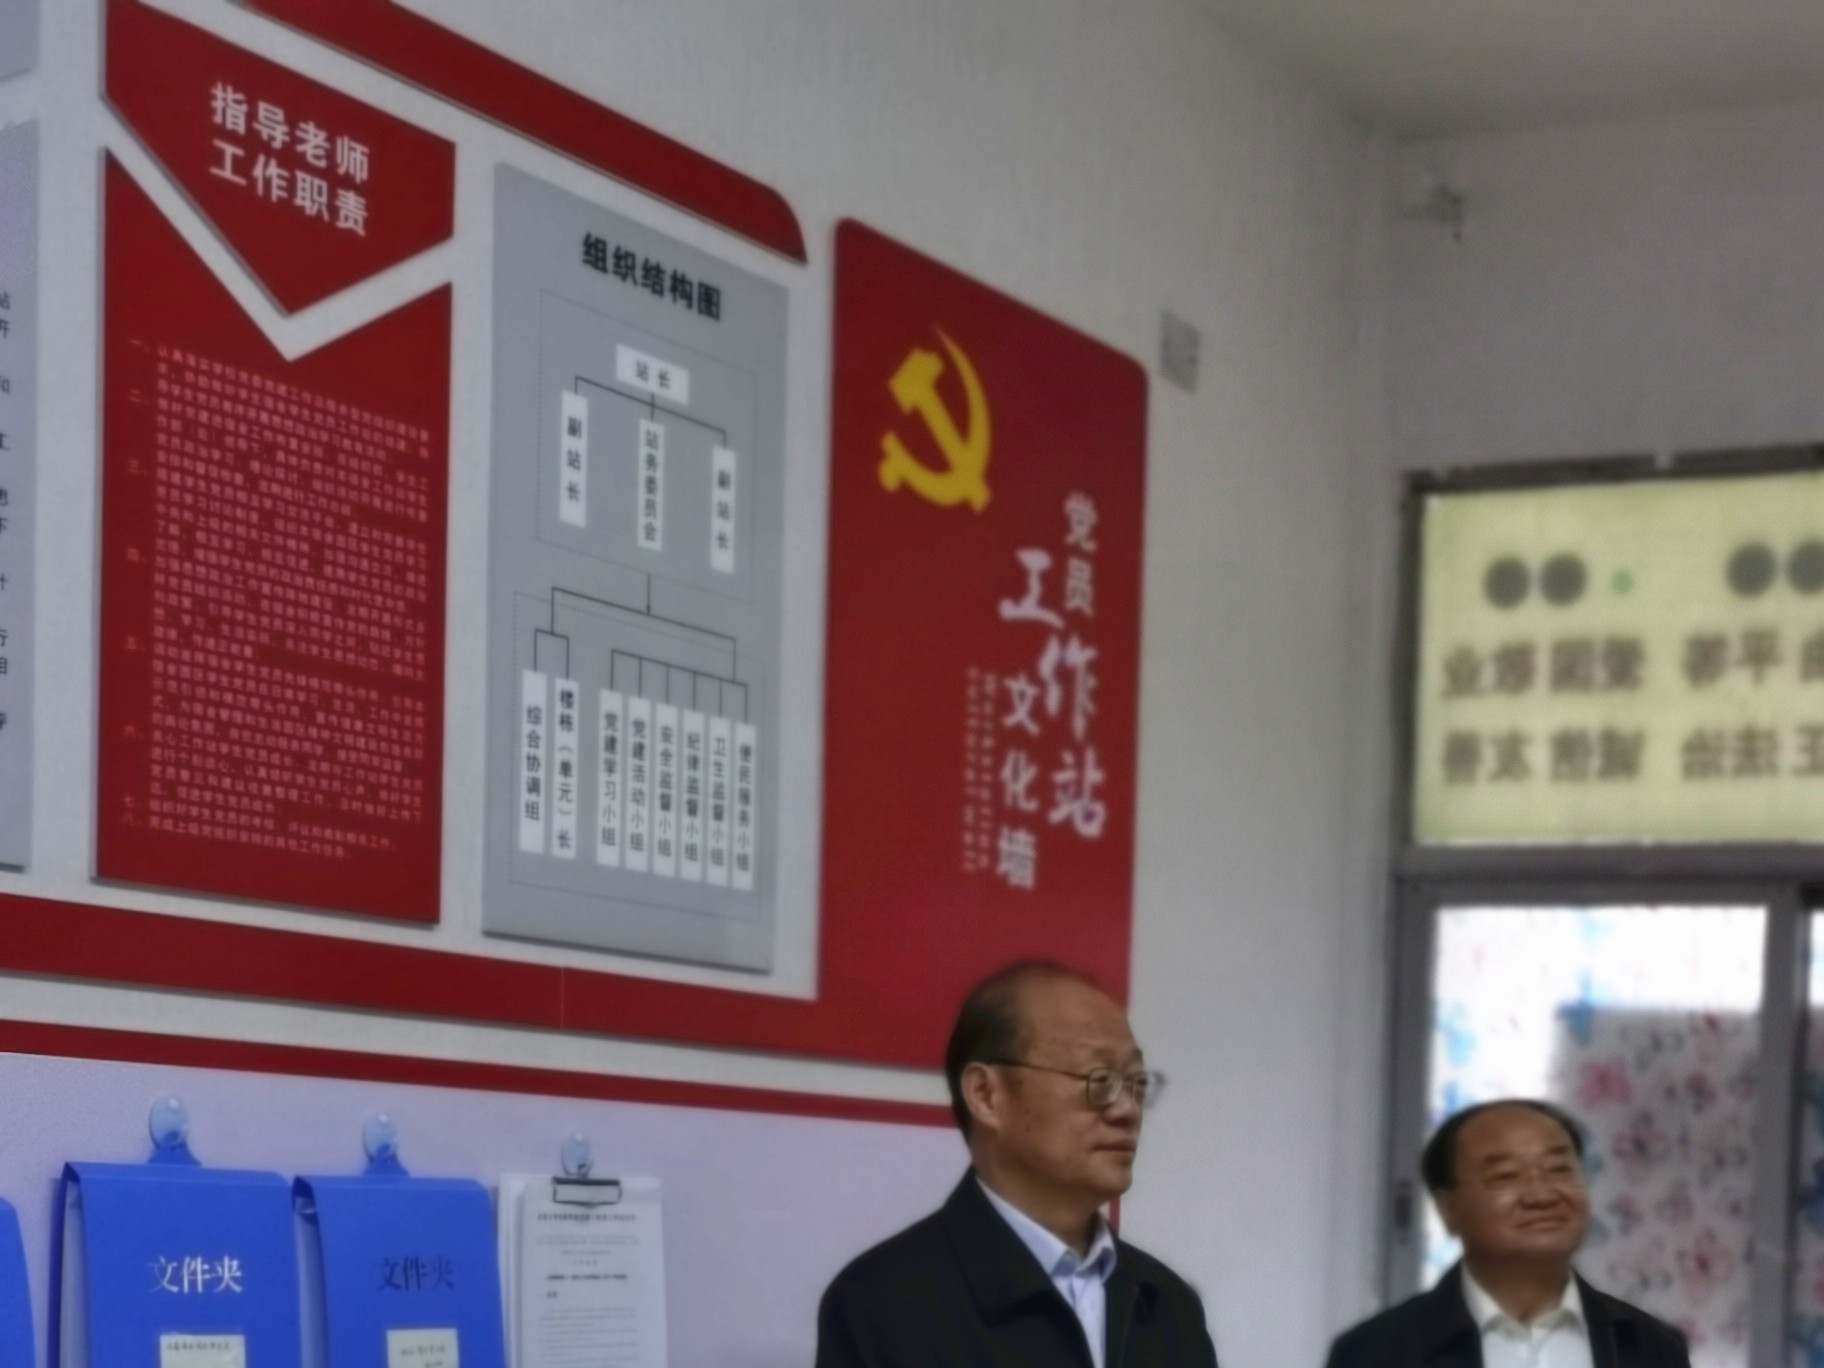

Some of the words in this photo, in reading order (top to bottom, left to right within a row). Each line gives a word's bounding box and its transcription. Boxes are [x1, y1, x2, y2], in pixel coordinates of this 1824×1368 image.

[211, 81, 371, 186] 指导老师
[210, 137, 370, 237] 工作职责
[582, 231, 721, 322] 组织结构图
[151, 1255, 243, 1295] 文件夹
[377, 1254, 456, 1292] 文件夹
